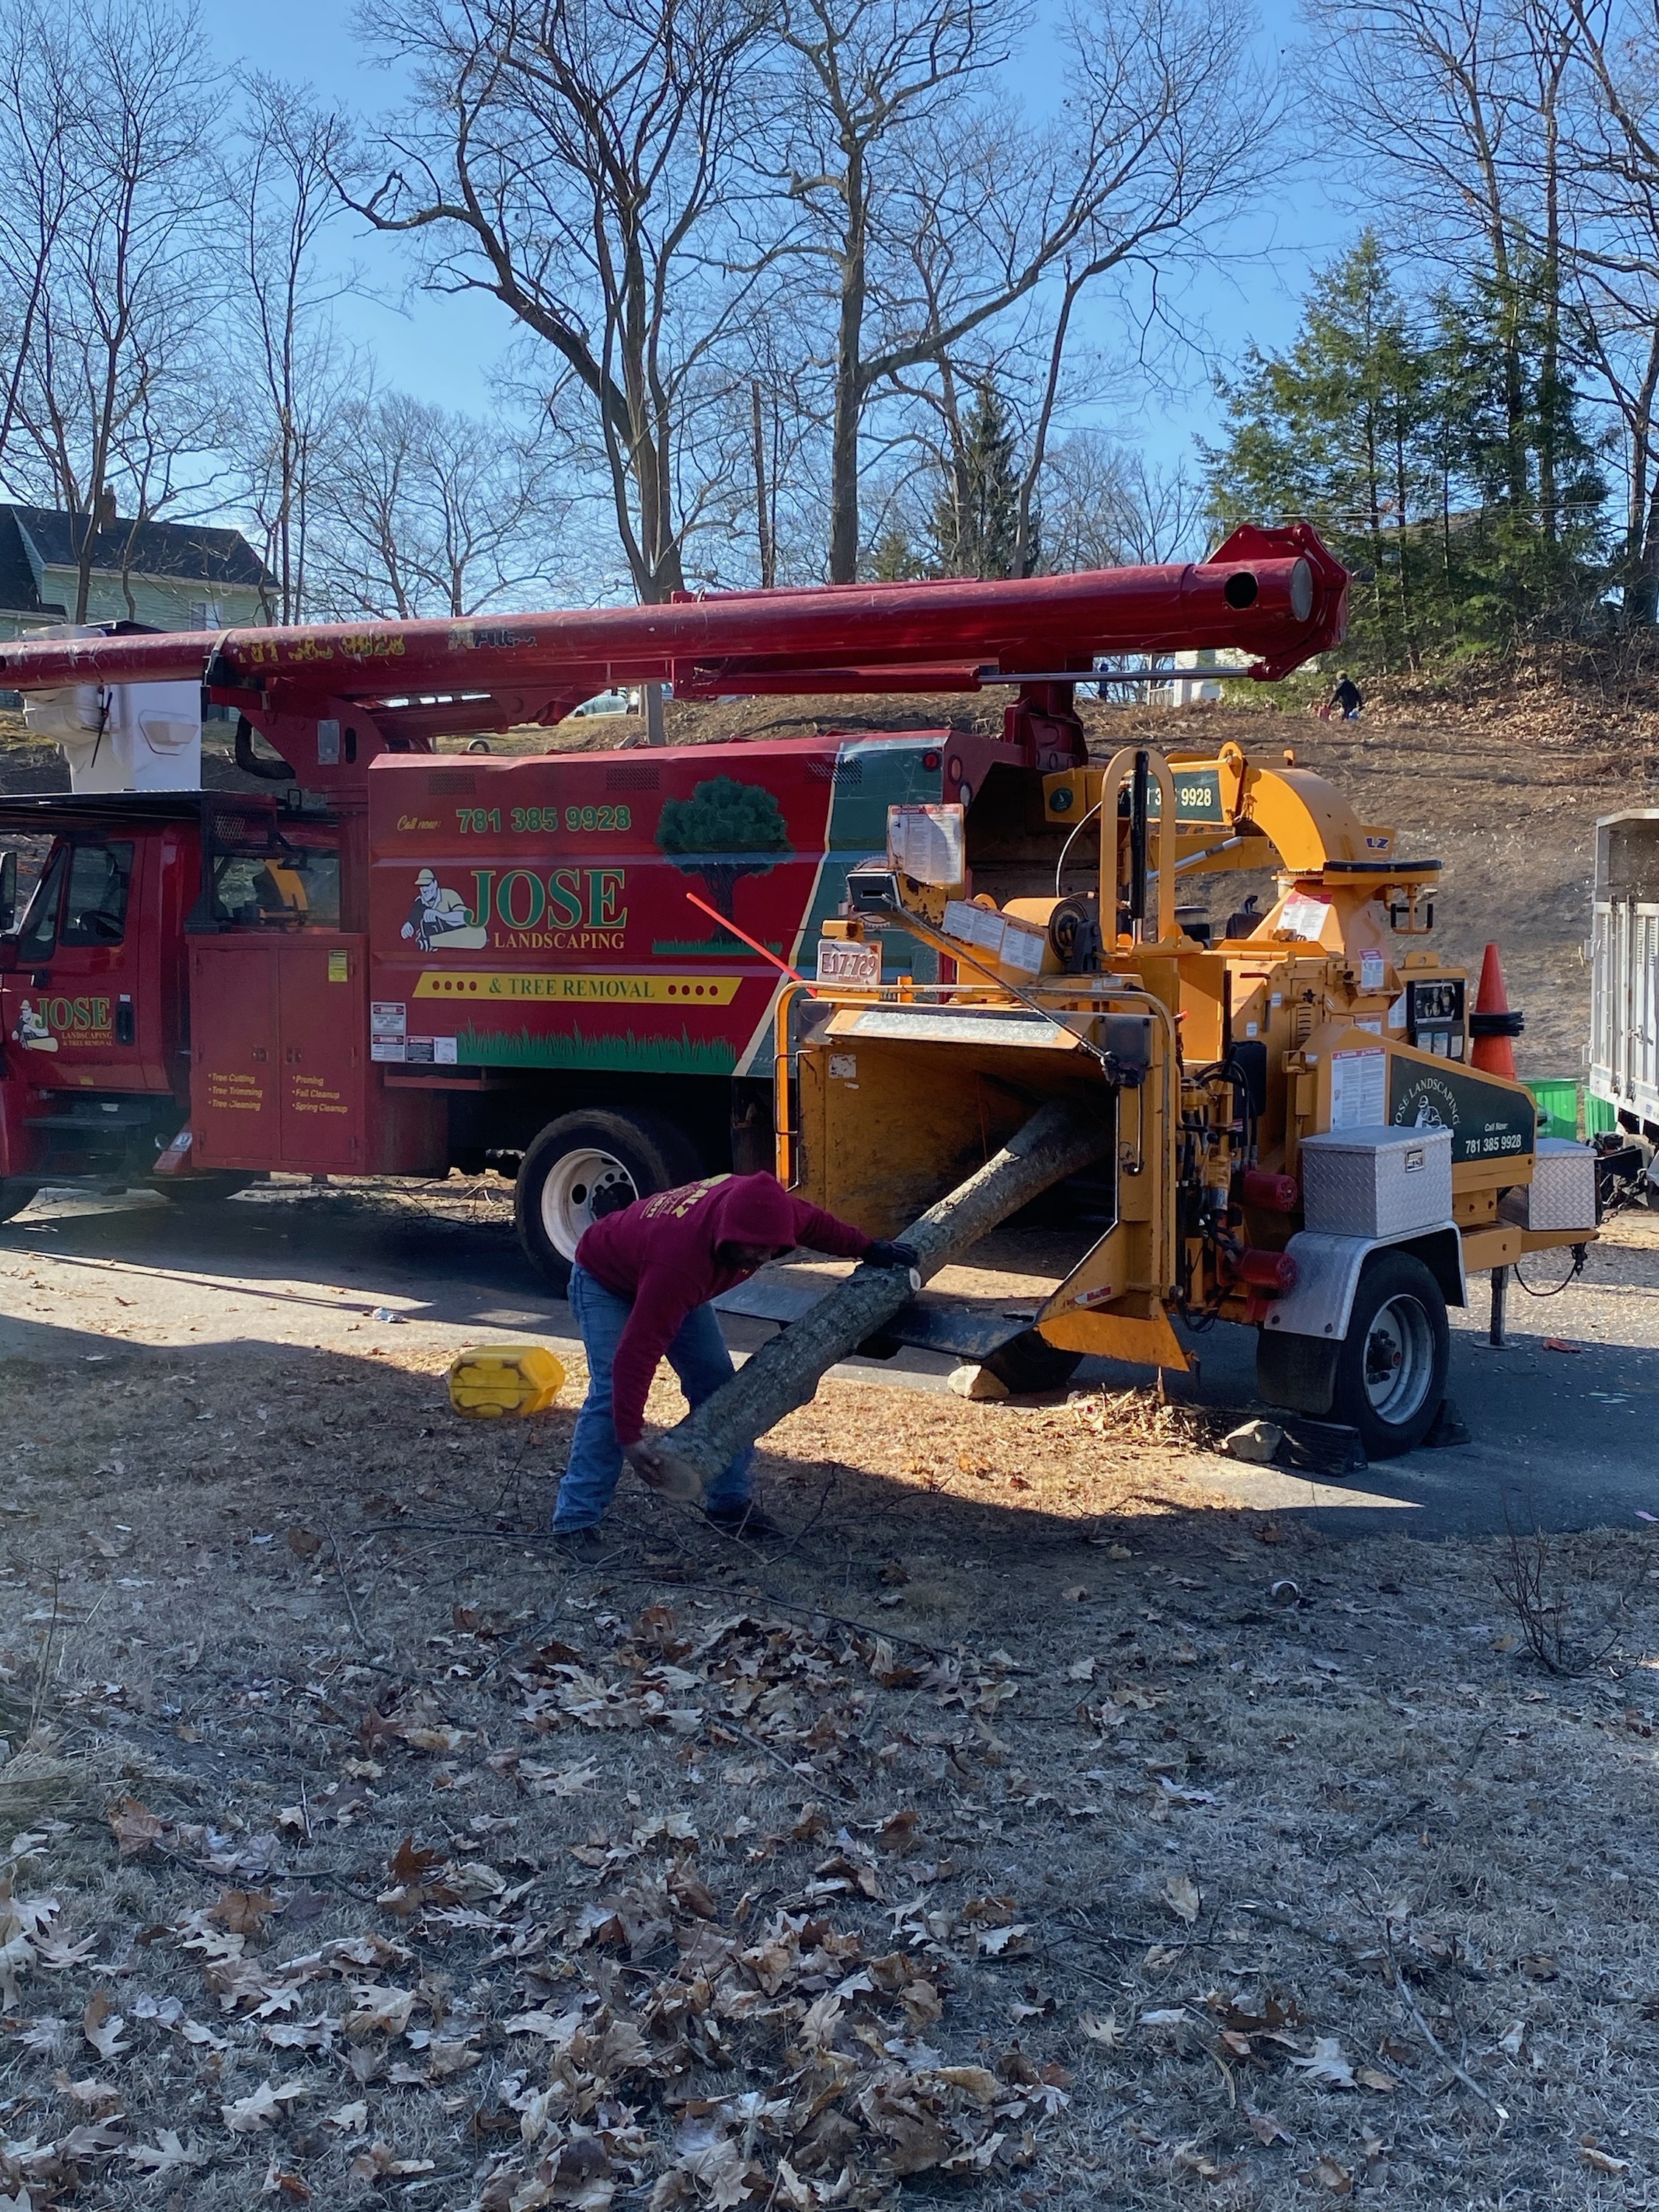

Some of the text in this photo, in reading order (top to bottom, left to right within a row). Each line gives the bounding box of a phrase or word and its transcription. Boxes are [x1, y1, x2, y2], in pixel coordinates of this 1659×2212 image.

[1180, 787, 1212, 807] 9928
[397, 815, 417, 831] Call
[456, 808, 501, 833] 781
[510, 807, 558, 832] 385
[565, 804, 632, 832] 9928
[463, 869, 627, 931] JOSE
[493, 932, 625, 950] LANDSCAPING
[488, 978, 655, 998] & TREE REMOVAL
[35, 997, 112, 1030] JOSE
[61, 1032, 113, 1040] LANDSCAPING
[1028, 1028, 1054, 1039] 9928
[212, 1073, 255, 1084] Tree Cutting
[296, 1075, 324, 1086] Pruning
[212, 1086, 262, 1098] Tree Trimming
[296, 1089, 340, 1100] Fall Cleanup
[212, 1099, 261, 1111] Tree Cleaning
[296, 1102, 348, 1114] Spring Cleanup
[1393, 1095, 1410, 1127] OSE
[1408, 1077, 1461, 1125] LANDSCAPING
[1484, 1122, 1495, 1132] Call
[1465, 1134, 1522, 1155] 781 385 9928
